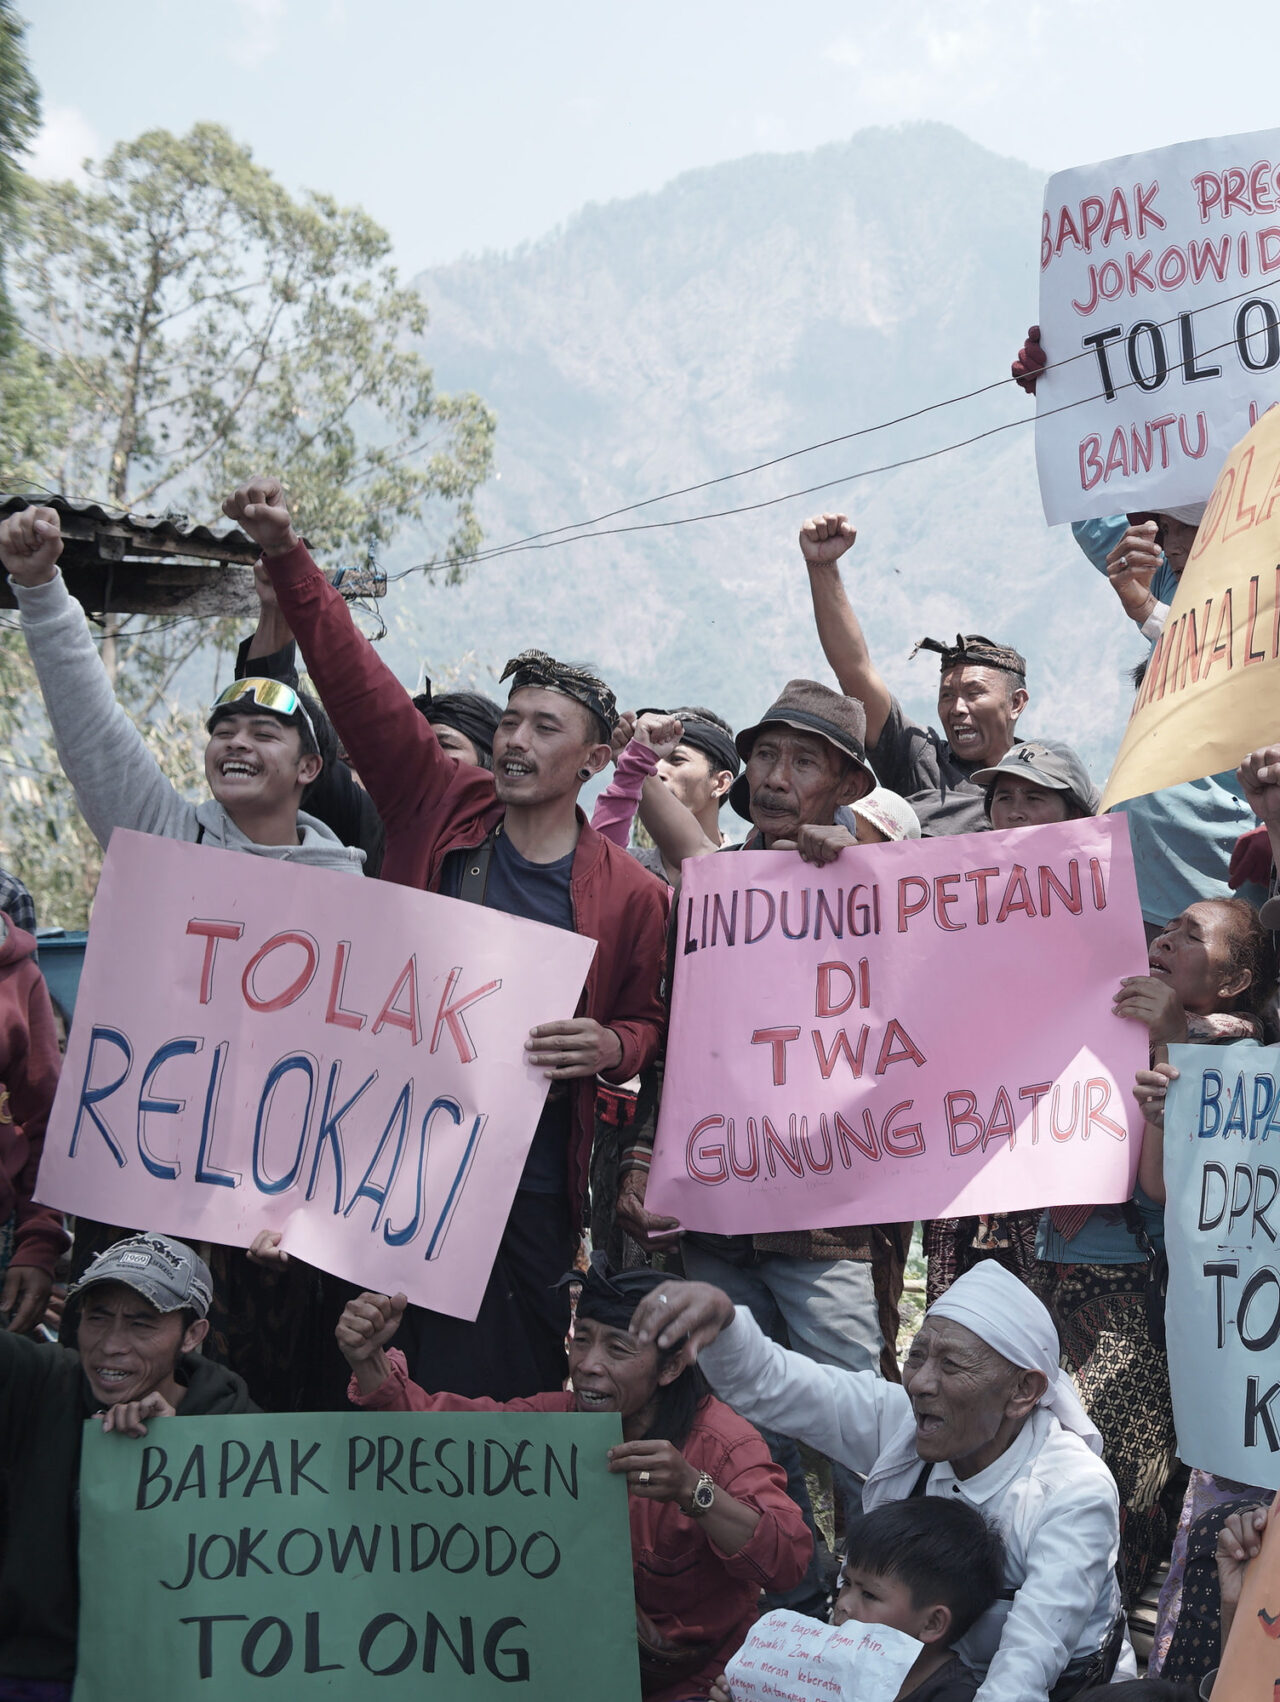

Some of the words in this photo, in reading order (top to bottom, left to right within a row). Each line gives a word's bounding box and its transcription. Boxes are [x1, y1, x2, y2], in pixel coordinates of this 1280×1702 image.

[1041, 179, 1167, 272] BAPAK
[1079, 410, 1209, 491] BANTU
[683, 884, 880, 956] LINDUNGI
[897, 857, 1107, 933] PETANI
[186, 917, 503, 1064] TOLAK
[815, 957, 870, 1018] DI
[751, 1018, 927, 1086] TWA
[68, 1024, 489, 1262] RELOKASI
[685, 1099, 926, 1186] GUNUNG
[943, 1076, 1127, 1157] BATUR
[135, 1438, 330, 1511] BAPAK
[347, 1436, 580, 1501] PRESIDEN
[158, 1522, 562, 1591] JOKOWIDODO
[178, 1611, 531, 1683] TOLONG
